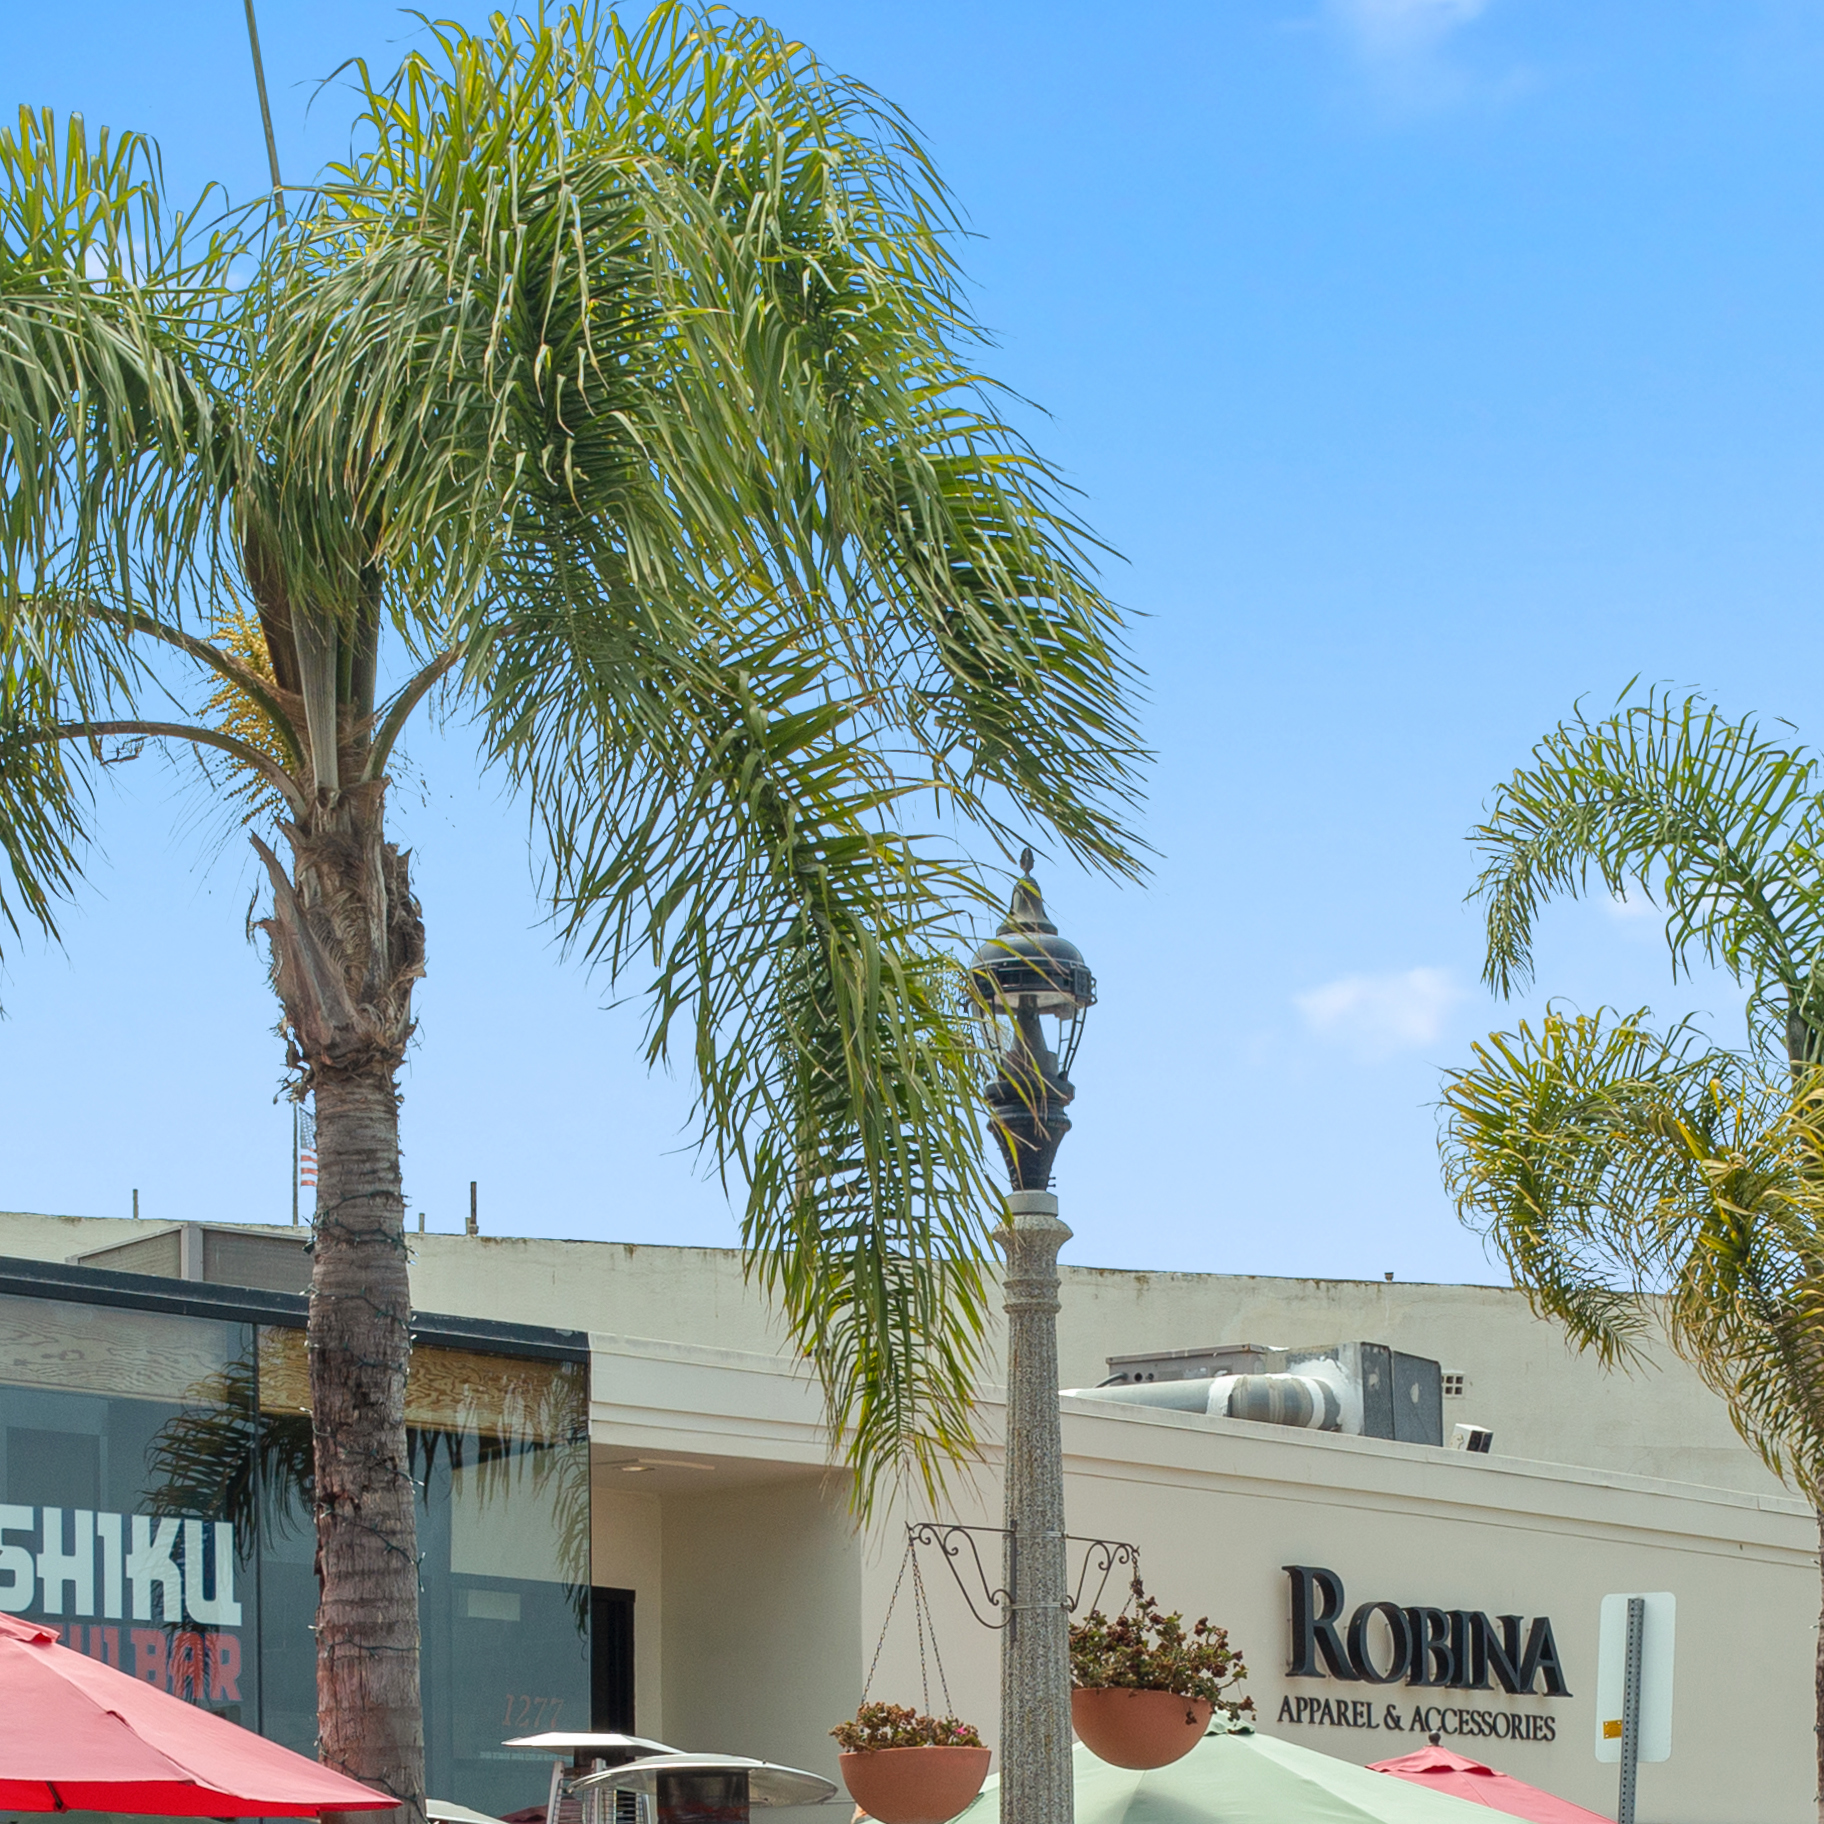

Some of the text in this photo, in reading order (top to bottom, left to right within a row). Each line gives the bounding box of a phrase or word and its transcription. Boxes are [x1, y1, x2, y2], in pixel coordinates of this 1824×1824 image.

[1281, 1565, 1574, 1698] ROBINA
[130, 1627, 243, 1701] BAR
[502, 1693, 565, 1729] 1277
[1277, 1695, 1557, 1742] APPAREL & ACCESSORIES
